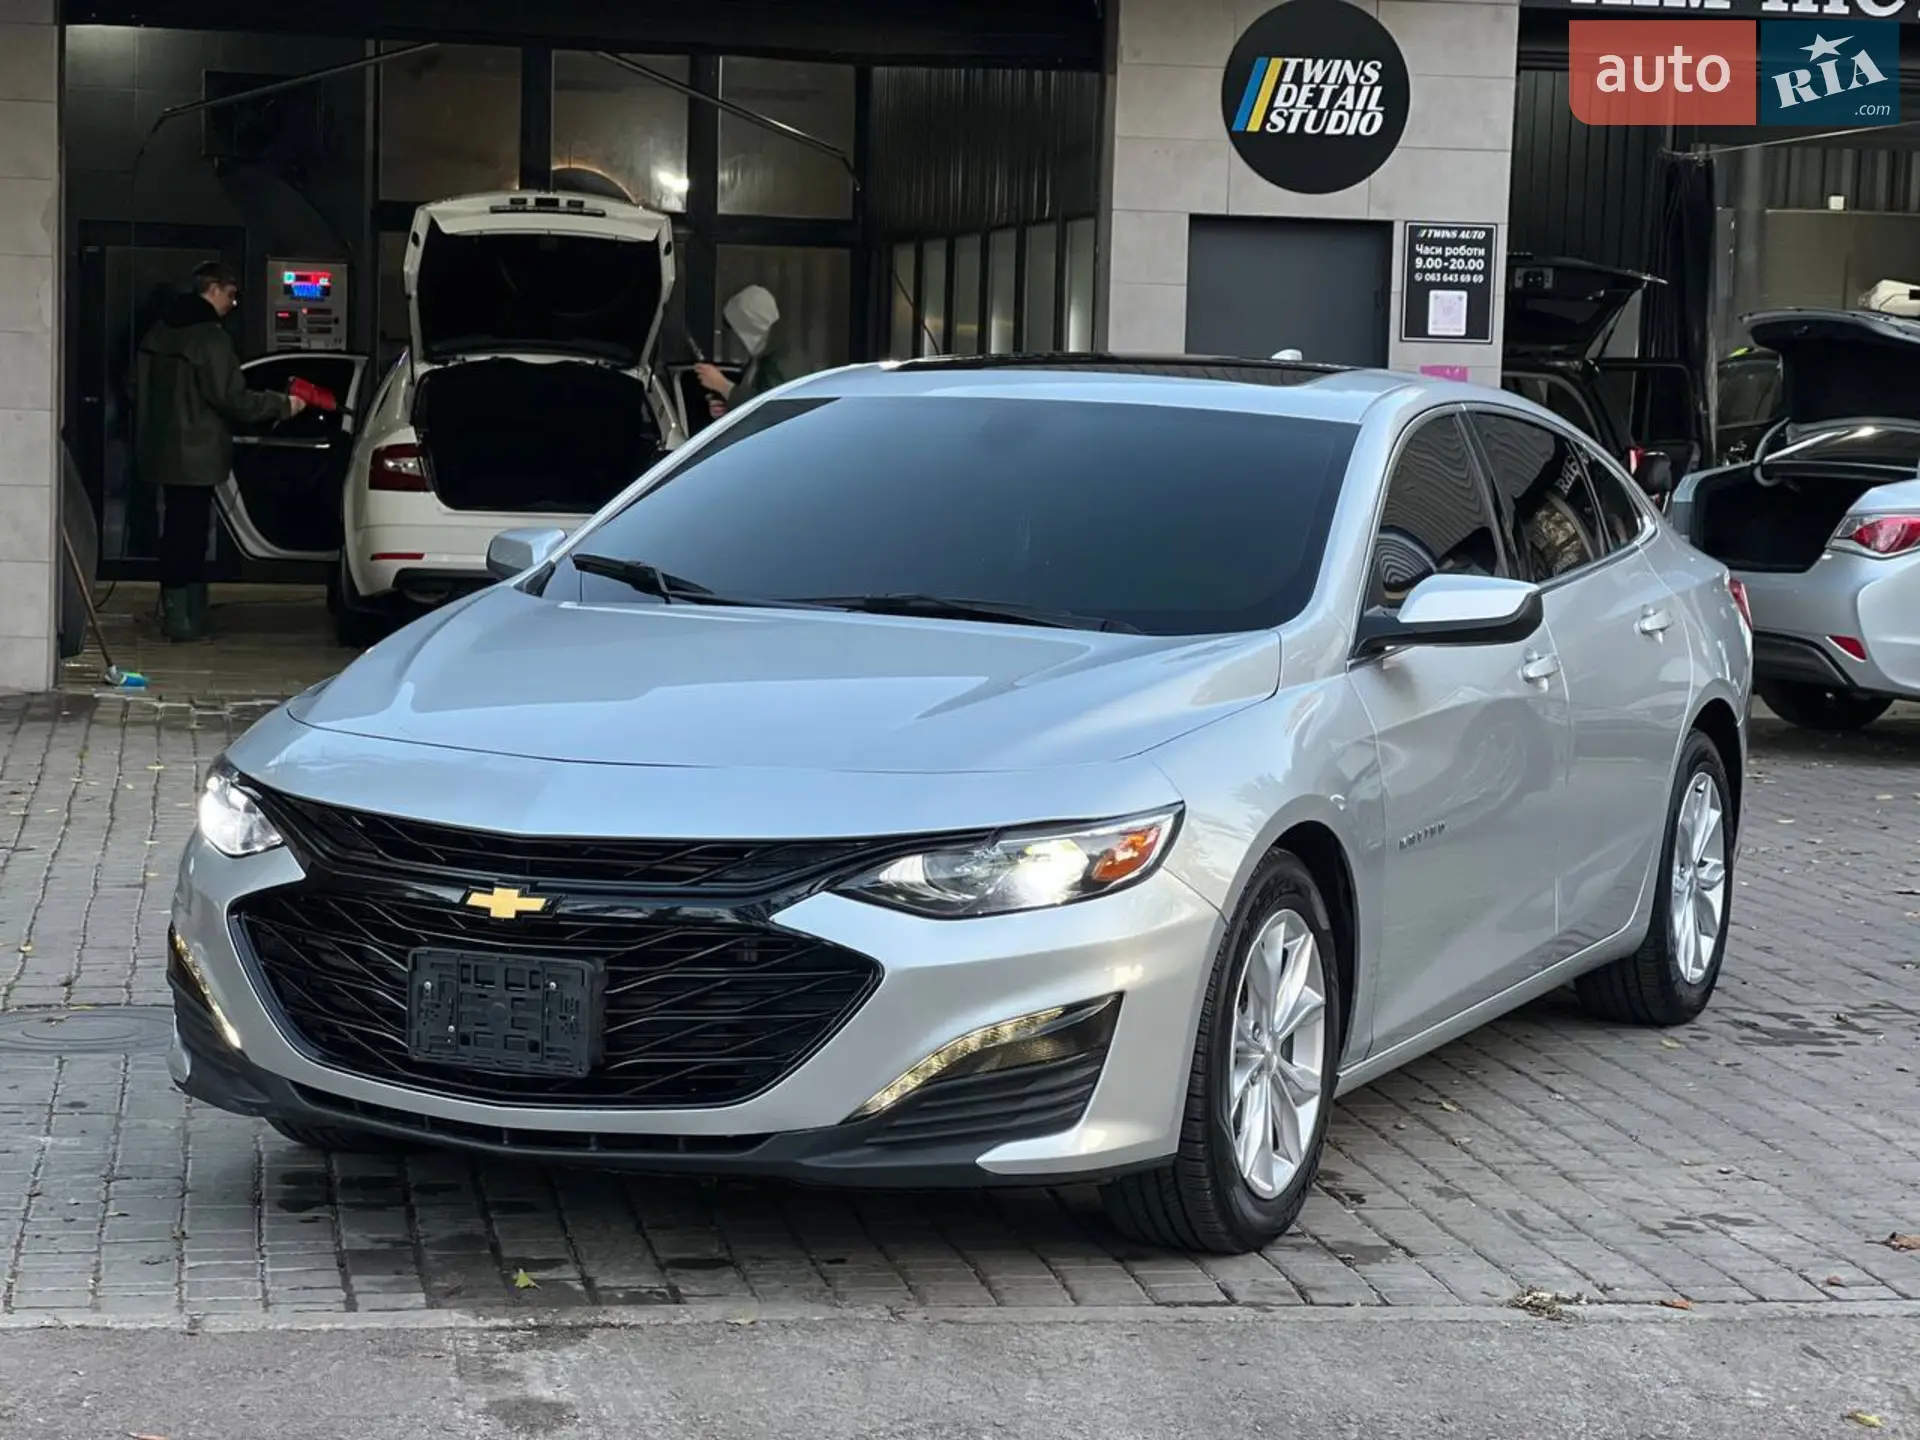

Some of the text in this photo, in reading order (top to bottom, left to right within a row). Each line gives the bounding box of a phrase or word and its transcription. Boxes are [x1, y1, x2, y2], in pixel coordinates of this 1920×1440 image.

[1281, 57, 1382, 85] TWINS
[1272, 83, 1385, 111] DETAIL
[1266, 109, 1384, 136] STUDIO
[1427, 229, 1486, 240] TWINS AUTO
[1415, 243, 1485, 257] Часи роботи
